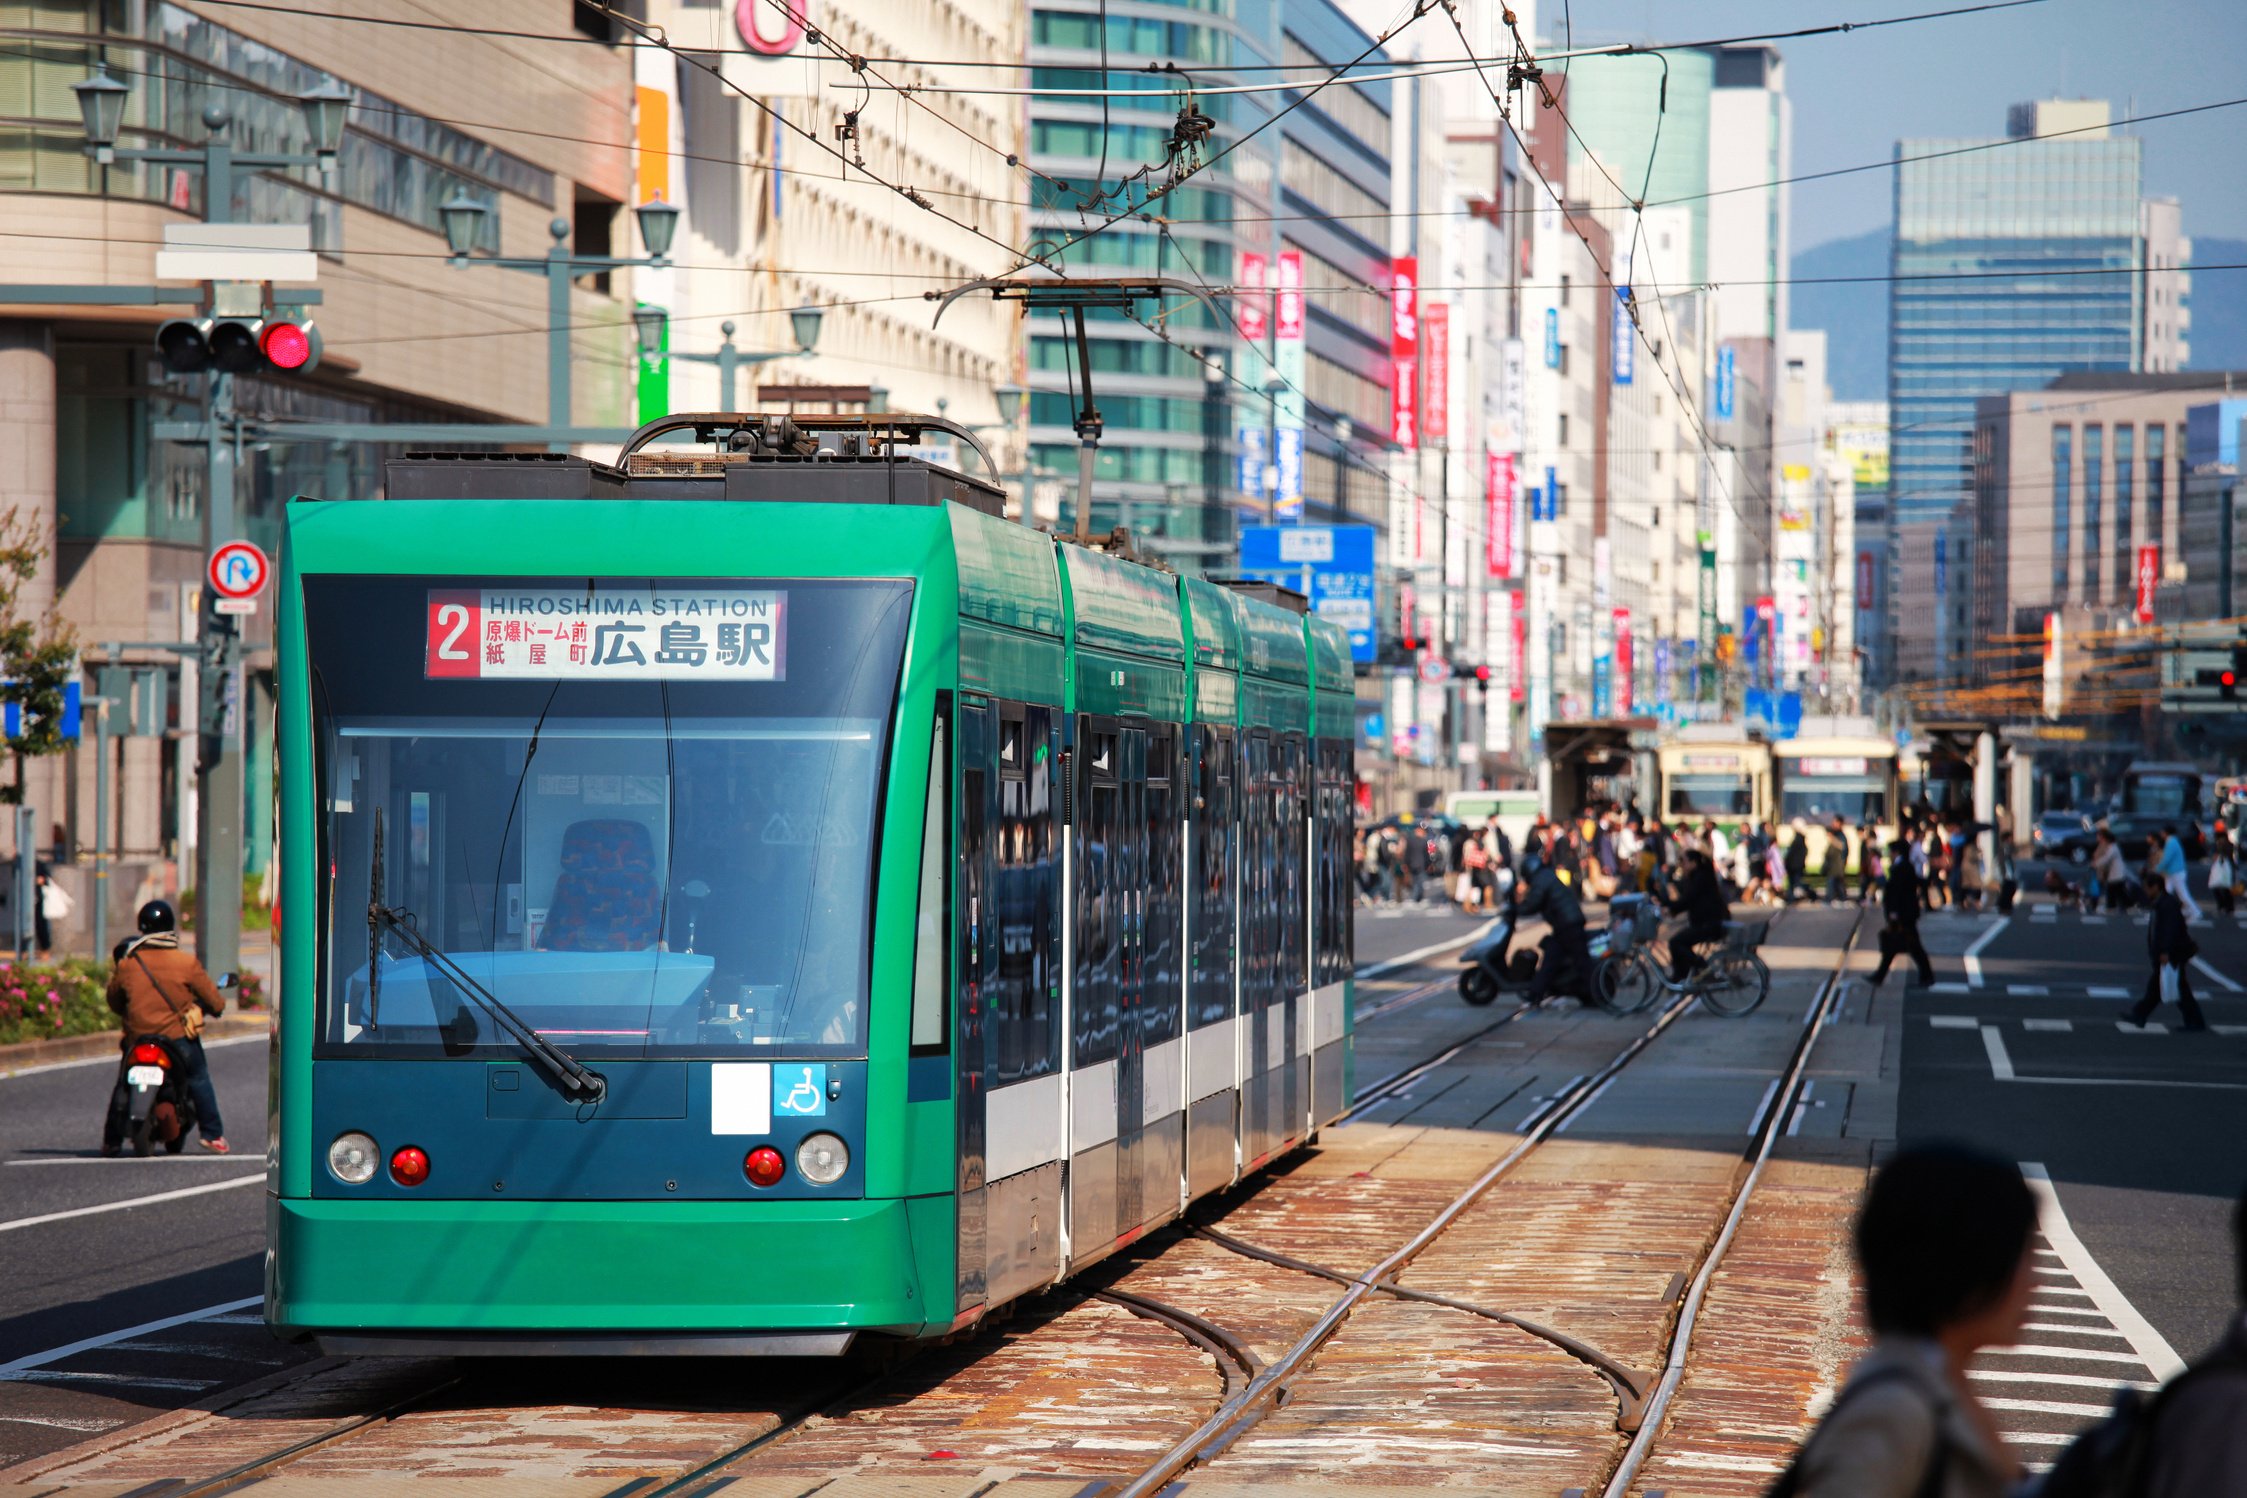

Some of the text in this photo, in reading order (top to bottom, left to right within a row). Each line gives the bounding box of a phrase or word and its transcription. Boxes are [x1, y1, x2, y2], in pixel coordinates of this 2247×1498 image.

[490, 597, 767, 617] HIROSHIMA STATION
[437, 604, 470, 660] 2
[486, 620, 588, 642] 原爆ドーム前
[486, 643, 588, 665] 紙屋町
[590, 620, 770, 667] 広島駅
